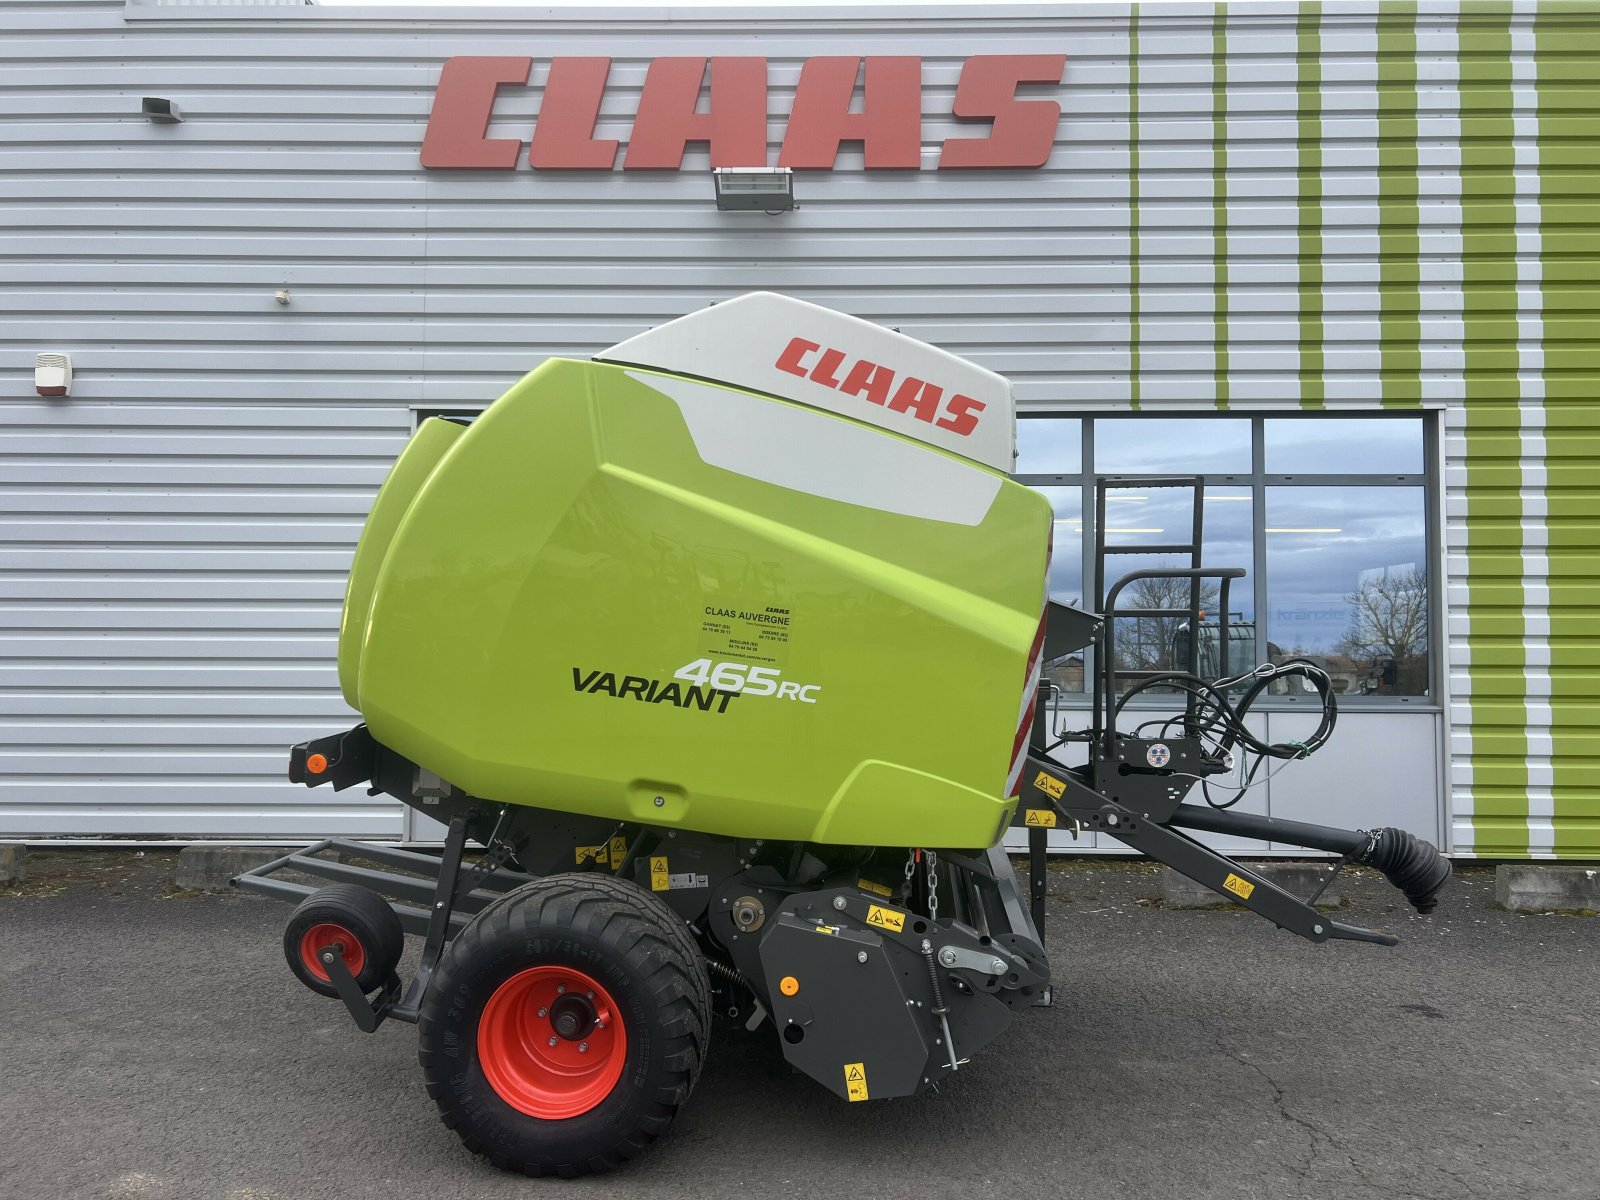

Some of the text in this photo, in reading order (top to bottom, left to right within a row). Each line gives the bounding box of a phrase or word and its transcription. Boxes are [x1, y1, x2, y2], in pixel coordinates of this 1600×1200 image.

[420, 54, 1066, 171] CLAAS
[775, 337, 987, 437] CLAAS
[703, 621, 721, 629] GANNAT
[705, 606, 736, 619] CLAAS
[738, 611, 790, 626] AUVERGNE
[765, 606, 790, 615] CLAAS
[572, 667, 741, 713] VARIANT
